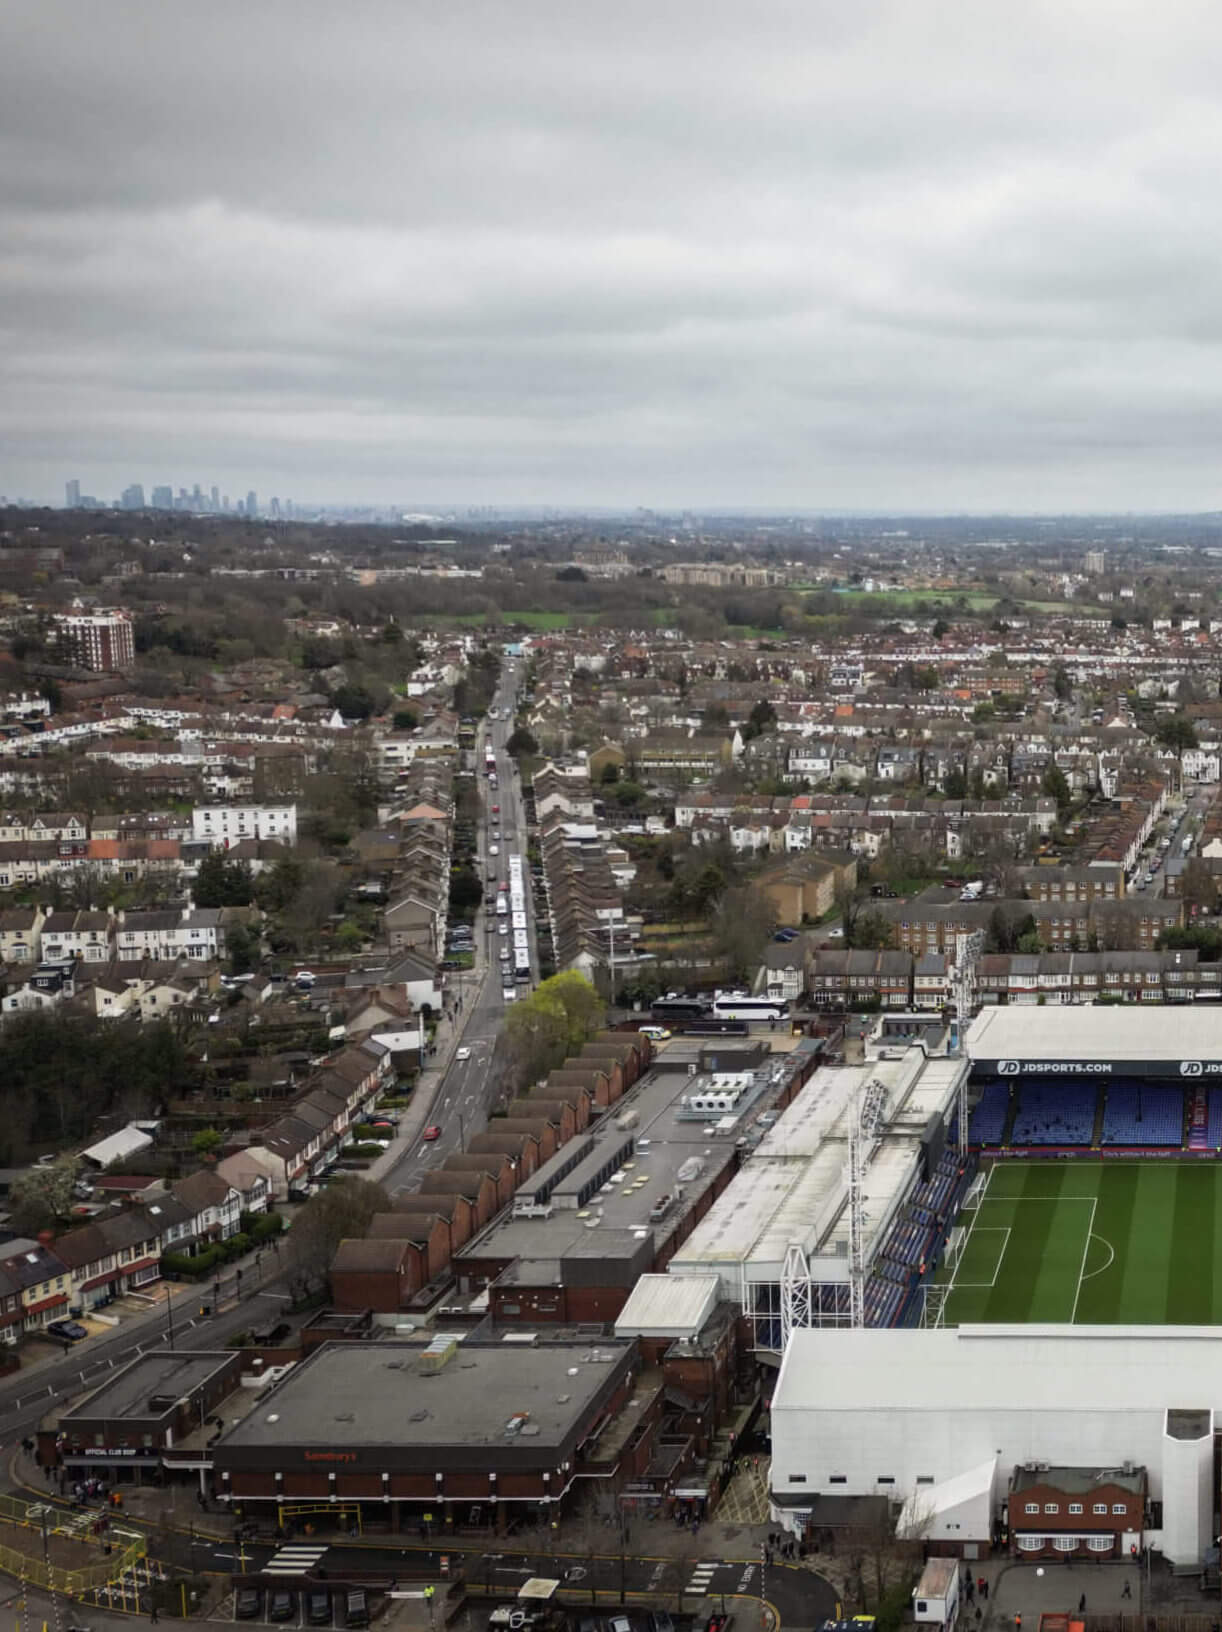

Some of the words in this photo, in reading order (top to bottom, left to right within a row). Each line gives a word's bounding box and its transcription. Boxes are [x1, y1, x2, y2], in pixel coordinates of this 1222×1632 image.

[998, 1060, 1020, 1075] JD
[1022, 1064, 1112, 1073] JDSPORTS.COM
[1180, 1061, 1203, 1076] JD
